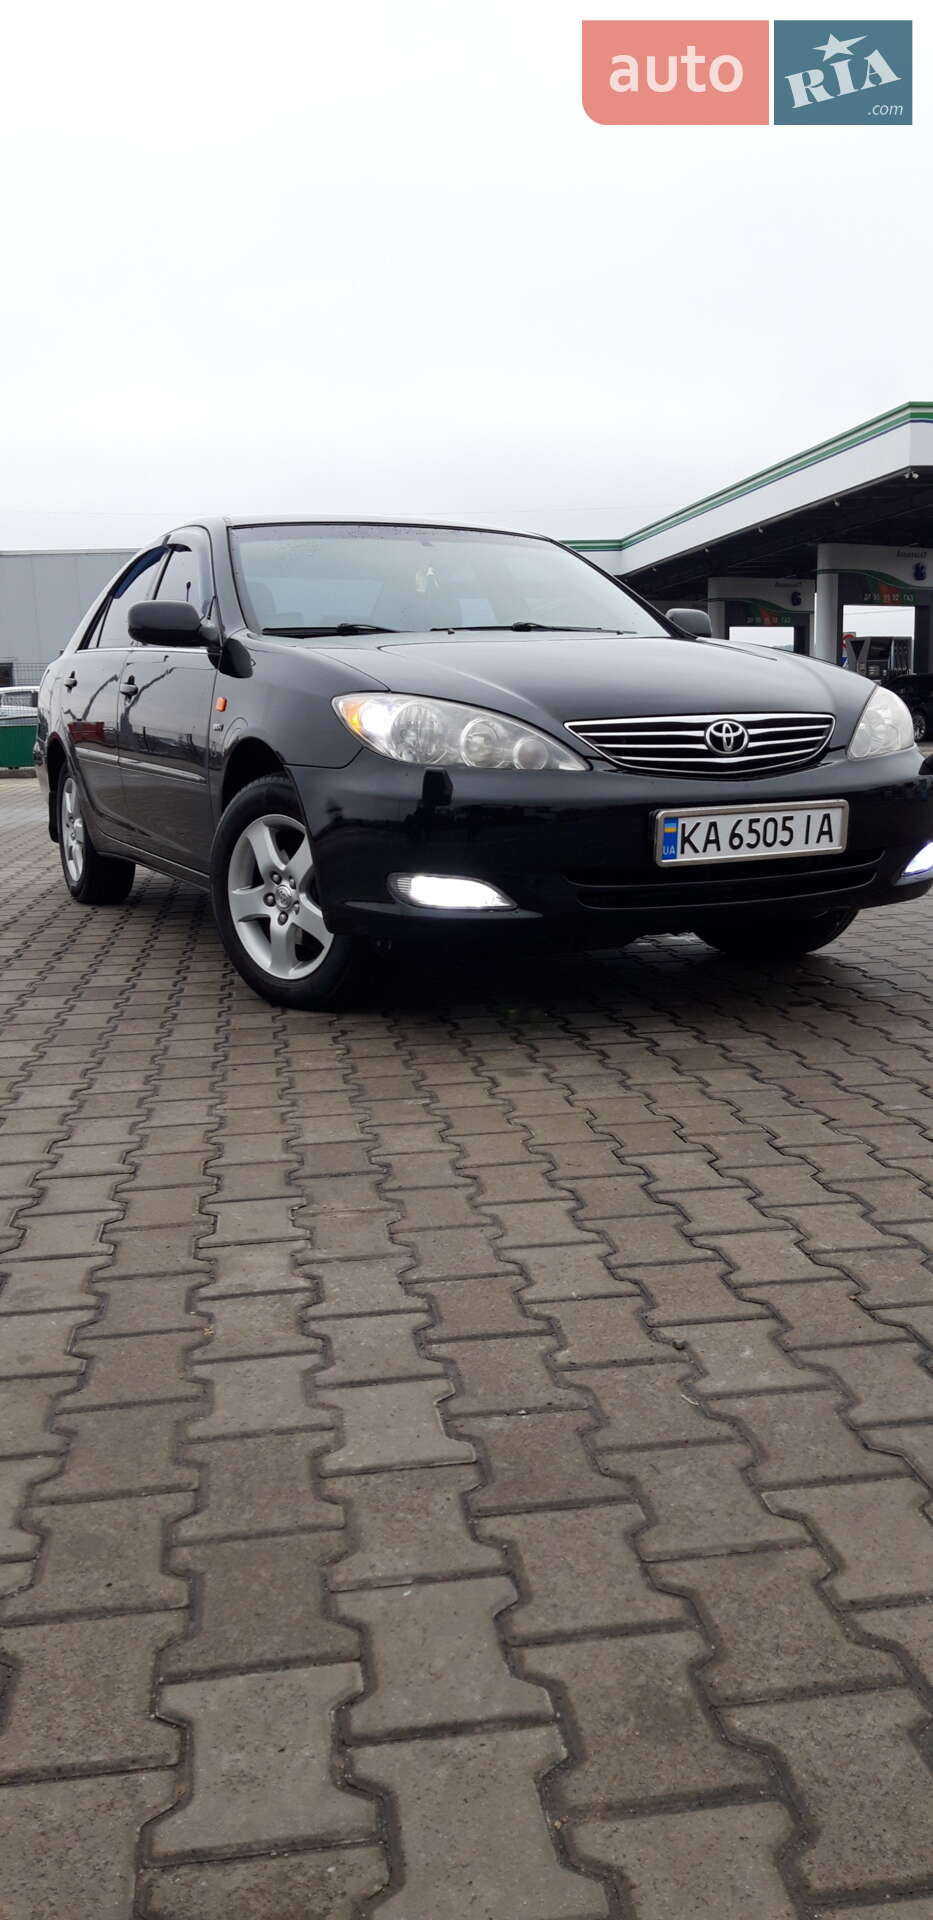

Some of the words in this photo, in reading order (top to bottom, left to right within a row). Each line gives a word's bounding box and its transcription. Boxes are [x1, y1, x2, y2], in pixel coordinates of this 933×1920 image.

[680, 821, 721, 854] KA
[728, 816, 794, 850] 6505
[804, 813, 833, 844] IA
[662, 845, 676, 856] UA
